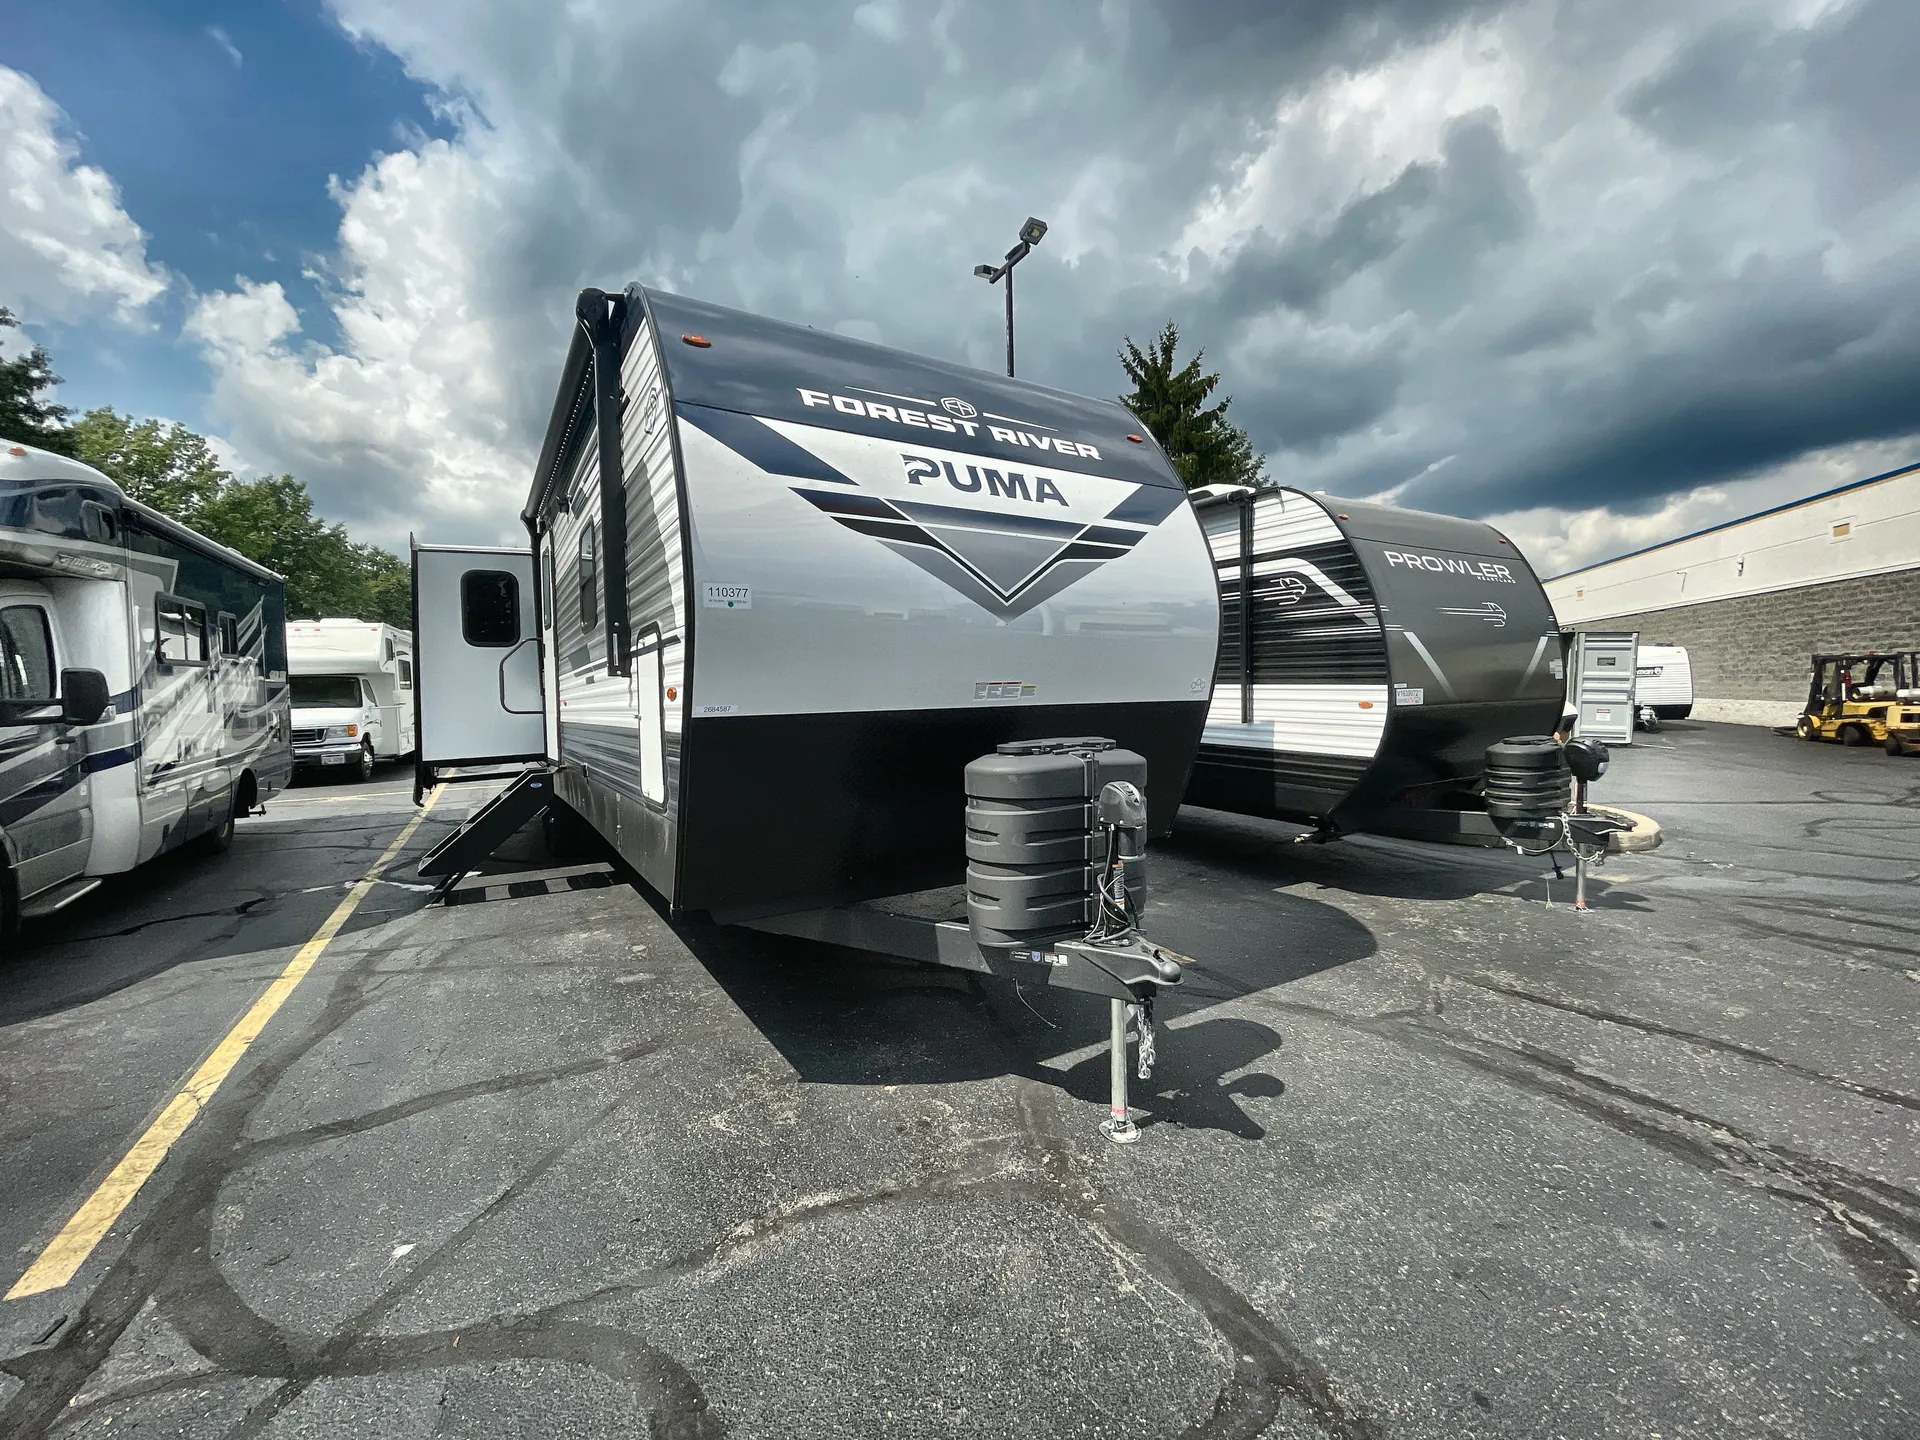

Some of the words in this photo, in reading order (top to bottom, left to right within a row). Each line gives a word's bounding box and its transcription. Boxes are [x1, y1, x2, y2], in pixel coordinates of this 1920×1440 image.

[796, 387, 979, 437] FOREST
[986, 424, 1103, 461] RIVER
[900, 453, 1070, 507] PUMA
[1383, 550, 1513, 580] PROWLER
[1476, 575, 1517, 584] HEARTLAND
[708, 586, 749, 598] 110377
[703, 705, 732, 713] 2684587
